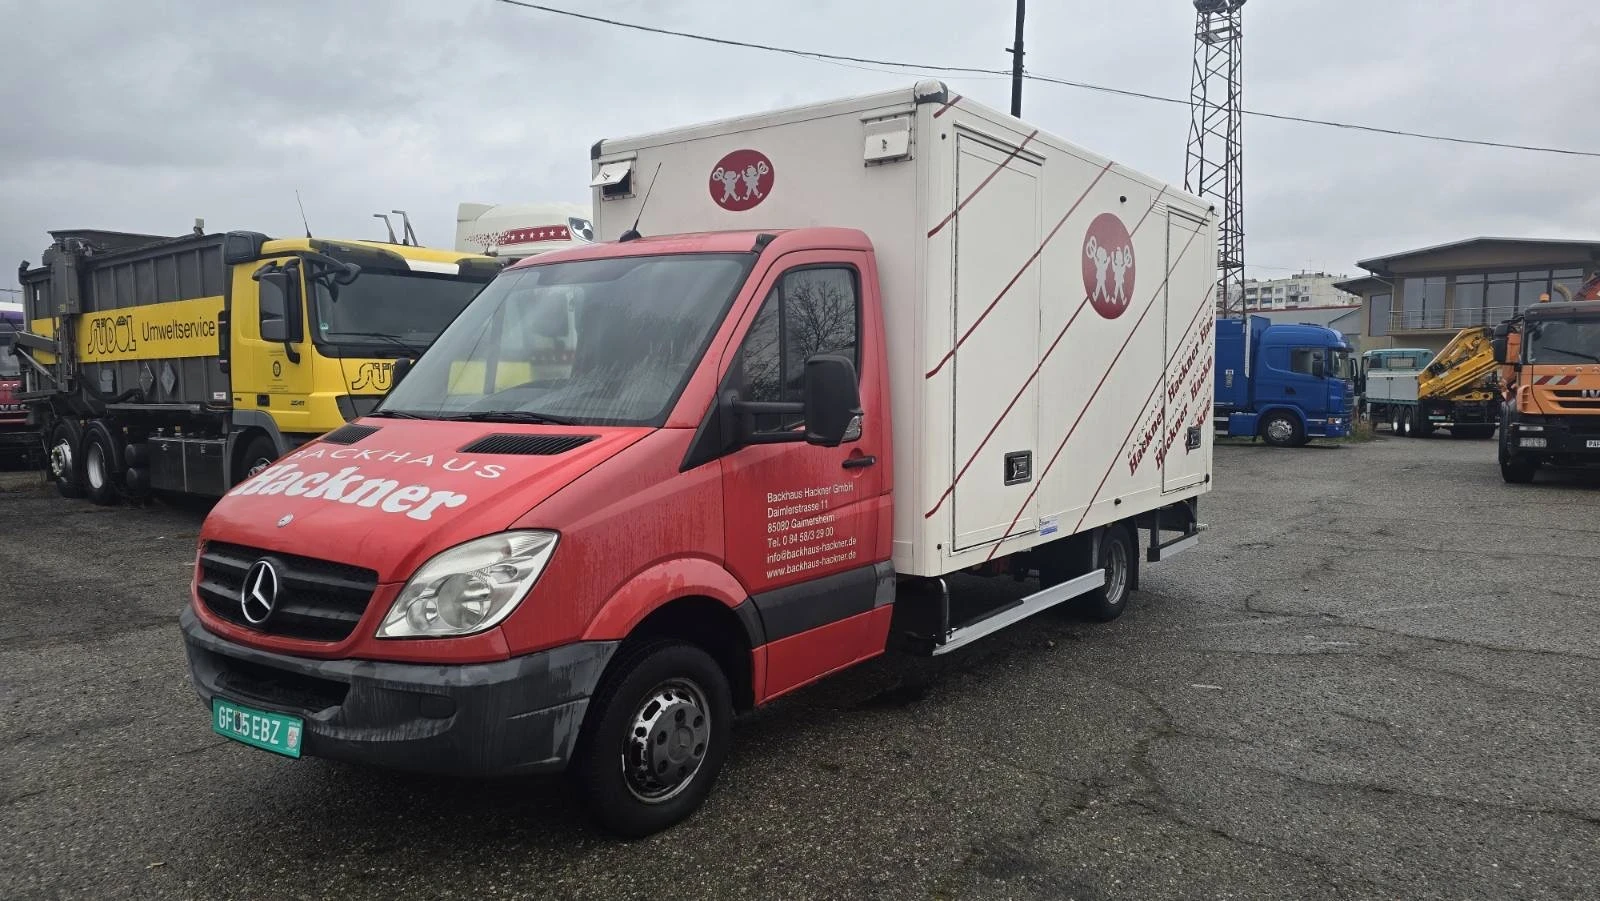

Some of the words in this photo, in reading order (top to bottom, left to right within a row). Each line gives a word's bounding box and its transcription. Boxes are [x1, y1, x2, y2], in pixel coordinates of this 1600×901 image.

[142, 316, 215, 341] Umweltservice
[351, 362, 395, 390] SÜ
[1167, 341, 1199, 404] Hackner
[1129, 405, 1165, 477] Hackner
[286, 448, 507, 479] BACKHAUS
[228, 463, 467, 521] Hackner
[767, 490, 803, 503] Backhaus
[804, 486, 832, 498] Hackner
[833, 482, 854, 494] GmbH
[767, 503, 819, 518] Daimlerstrasse
[821, 499, 828, 510] 11
[767, 520, 790, 533] 85080
[791, 514, 835, 529] Gaimersheim
[768, 536, 781, 548] Tel.
[782, 535, 787, 546] 0
[789, 533, 798, 544] 84
[799, 530, 815, 543] 58/3
[816, 528, 824, 539] 29
[825, 526, 834, 537] 00
[767, 536, 857, 564] info@backhaus-hackner.de
[767, 551, 857, 579] www.backhaus-hackner.de
